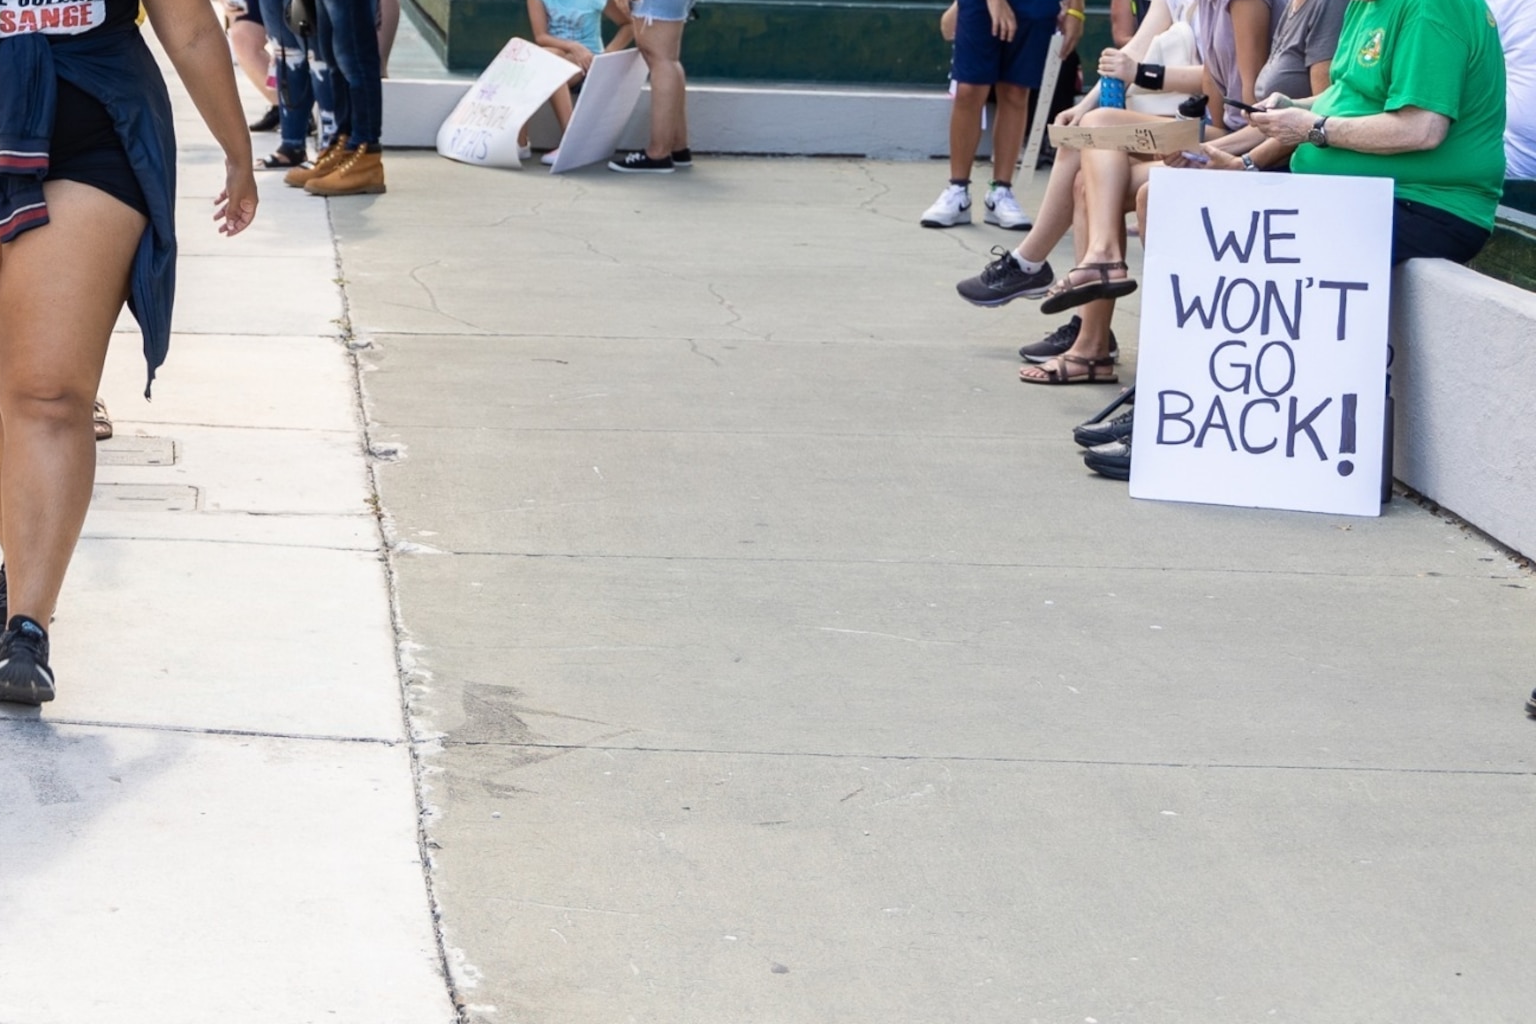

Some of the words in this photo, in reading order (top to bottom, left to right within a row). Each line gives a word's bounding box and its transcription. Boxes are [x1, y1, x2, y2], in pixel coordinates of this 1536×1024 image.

[1201, 207, 1301, 264] WE
[1170, 275, 1369, 340] WON'T
[1209, 340, 1295, 397] GO
[1156, 390, 1358, 477] BACK!
